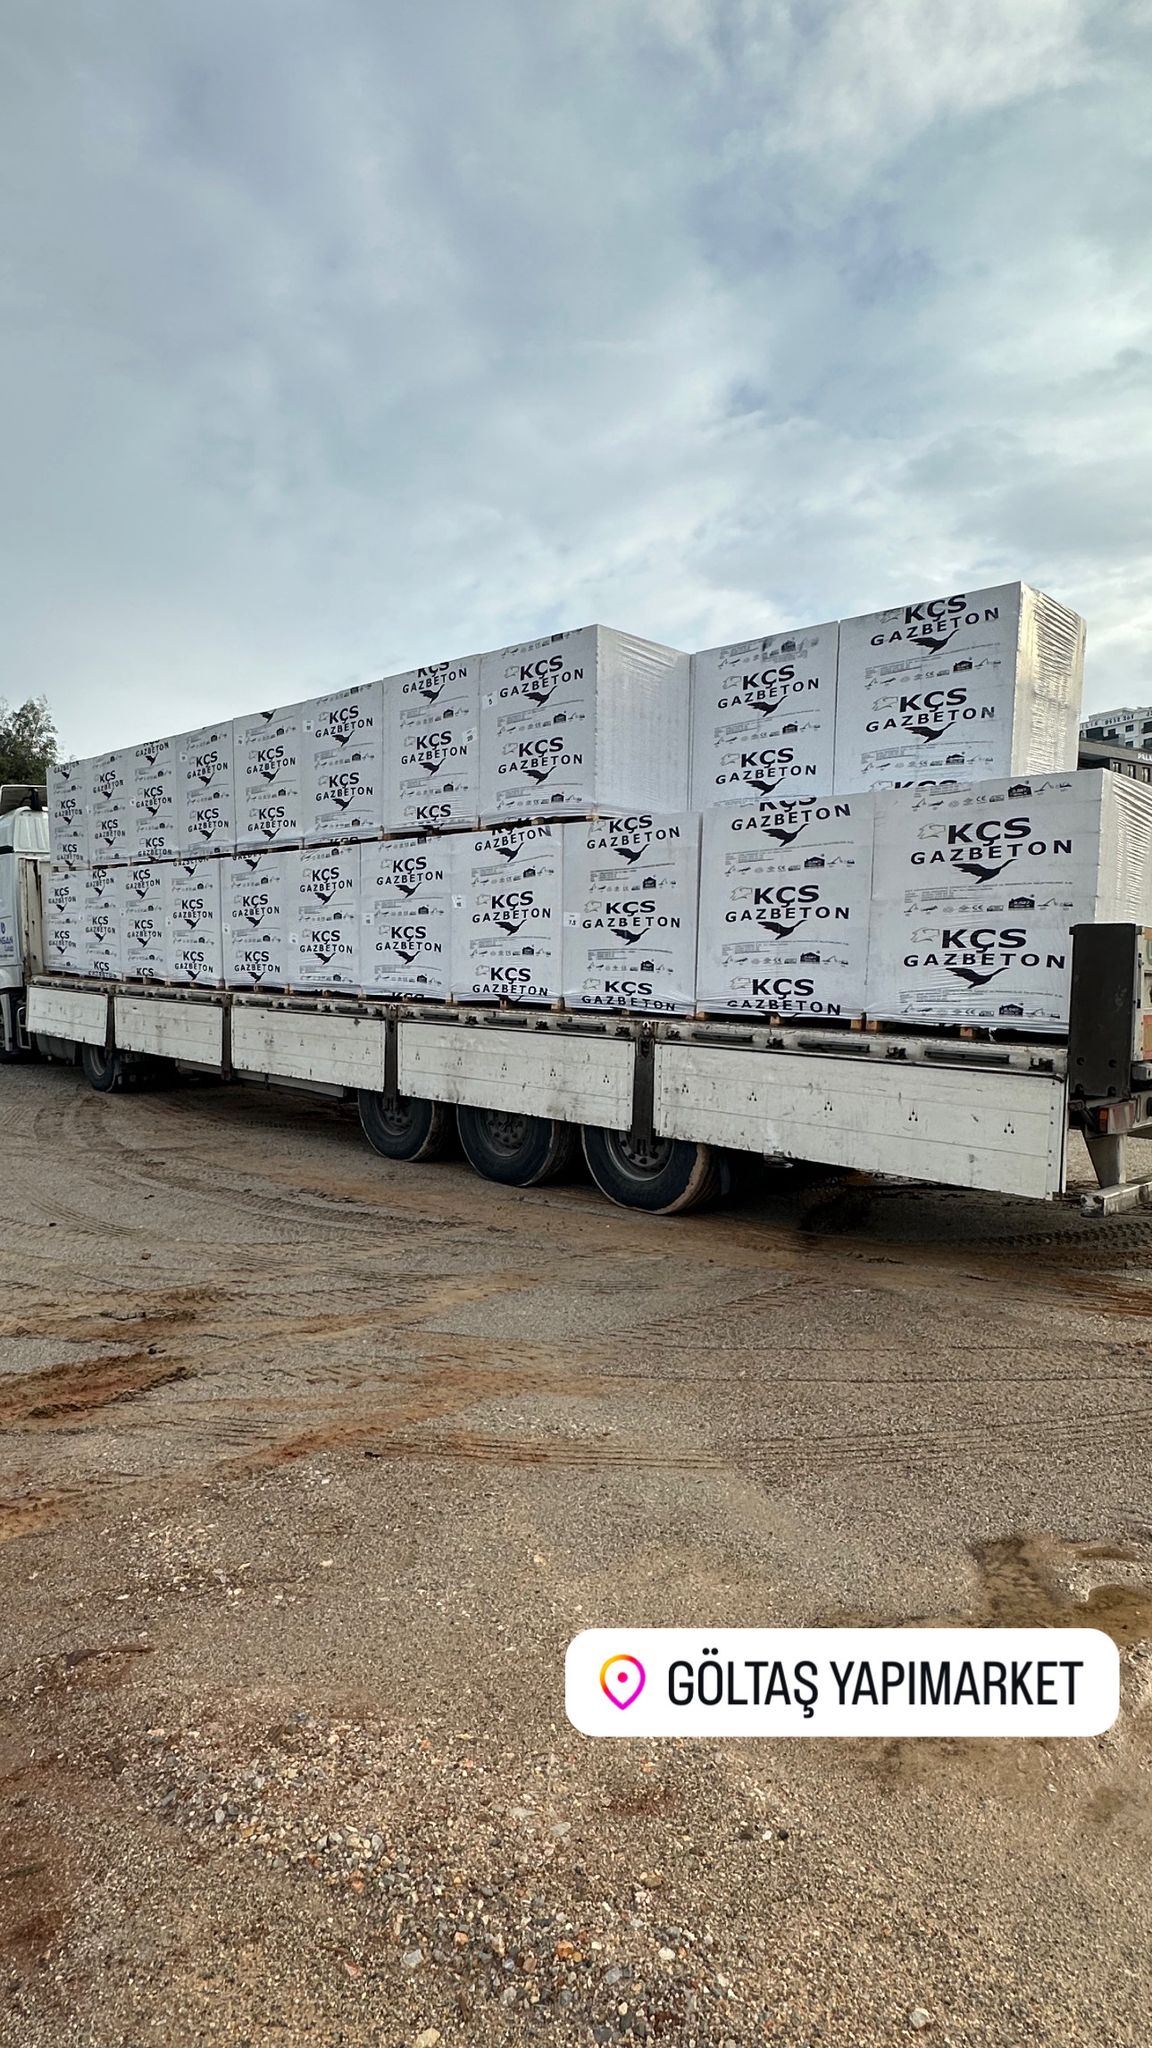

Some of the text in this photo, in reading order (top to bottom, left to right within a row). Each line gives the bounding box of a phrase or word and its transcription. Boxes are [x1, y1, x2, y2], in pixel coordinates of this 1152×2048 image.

[905, 594, 967, 624] KÇS
[871, 608, 999, 646] GAZBETON
[520, 655, 563, 680] KÇS
[403, 668, 467, 694] GAZBETON
[500, 668, 584, 698] GAZBETON
[743, 665, 795, 690] KÇS
[718, 678, 819, 708] GAZBETON
[900, 688, 966, 712] KÇS
[329, 706, 359, 724] KÇS
[866, 706, 994, 732] GAZBETON
[315, 718, 373, 738] GAZBETON
[416, 731, 451, 750] KÇS
[519, 737, 563, 758] KÇS
[196, 751, 218, 767] KÇS
[258, 746, 284, 762] KÇS
[401, 746, 467, 765] GAZBETON
[741, 748, 793, 768] KÇS
[187, 762, 228, 779] GAZBETON
[247, 757, 296, 774] GAZBETON
[499, 754, 582, 773] GAZBETON
[100, 770, 116, 783] KÇS
[329, 772, 359, 788] KÇS
[716, 765, 816, 784] GAZBETON
[144, 786, 164, 799] KÇS
[316, 787, 373, 801] GAZBETON
[60, 799, 76, 810] KÇS
[416, 804, 451, 820] KÇS
[197, 808, 219, 822] KÇS
[259, 806, 284, 821] KÇS
[732, 804, 850, 830] GAZBETON
[102, 819, 118, 832] KÇS
[188, 821, 229, 832] GAZBETON
[248, 820, 296, 831] GAZBETON
[610, 815, 653, 834] KÇS
[948, 818, 1031, 846] KÇS
[146, 837, 164, 849] KÇS
[475, 826, 551, 851] GAZBETON
[587, 826, 680, 849] GAZBETON
[911, 840, 1072, 864] GAZBETON
[393, 857, 427, 874] KÇS
[133, 869, 150, 881] KÇS
[312, 867, 339, 883] KÇS
[377, 871, 443, 885] GAZBETON
[300, 880, 352, 892] GAZBETON
[182, 899, 203, 910] KÇS
[243, 894, 268, 907] KÇS
[492, 891, 533, 910] KÇS
[754, 885, 819, 908] KÇS
[173, 911, 213, 919] GAZBETON
[232, 907, 279, 917] GAZBETON
[473, 908, 551, 923] GAZBETON
[606, 900, 655, 915] KÇS
[726, 907, 849, 922] GAZBETON
[135, 920, 153, 931] KÇS
[583, 916, 680, 928] GAZBETON
[312, 930, 340, 944] KÇS
[391, 927, 426, 941] KÇS
[942, 929, 1027, 952] KÇS
[300, 945, 352, 954] GAZBETON
[376, 942, 441, 952] GAZBETON
[183, 951, 204, 963] KÇS
[245, 951, 269, 963] KÇS
[904, 954, 1065, 969] GAZBETON
[175, 963, 213, 972] GAZBETON
[235, 964, 280, 973] GAZBETON
[491, 968, 531, 983] KÇS
[473, 984, 547, 996] GAZBETON
[605, 981, 653, 996] KÇS
[753, 979, 814, 999] KÇS
[582, 995, 675, 1011] GAZBETON
[728, 1000, 841, 1015] GAZBETON
